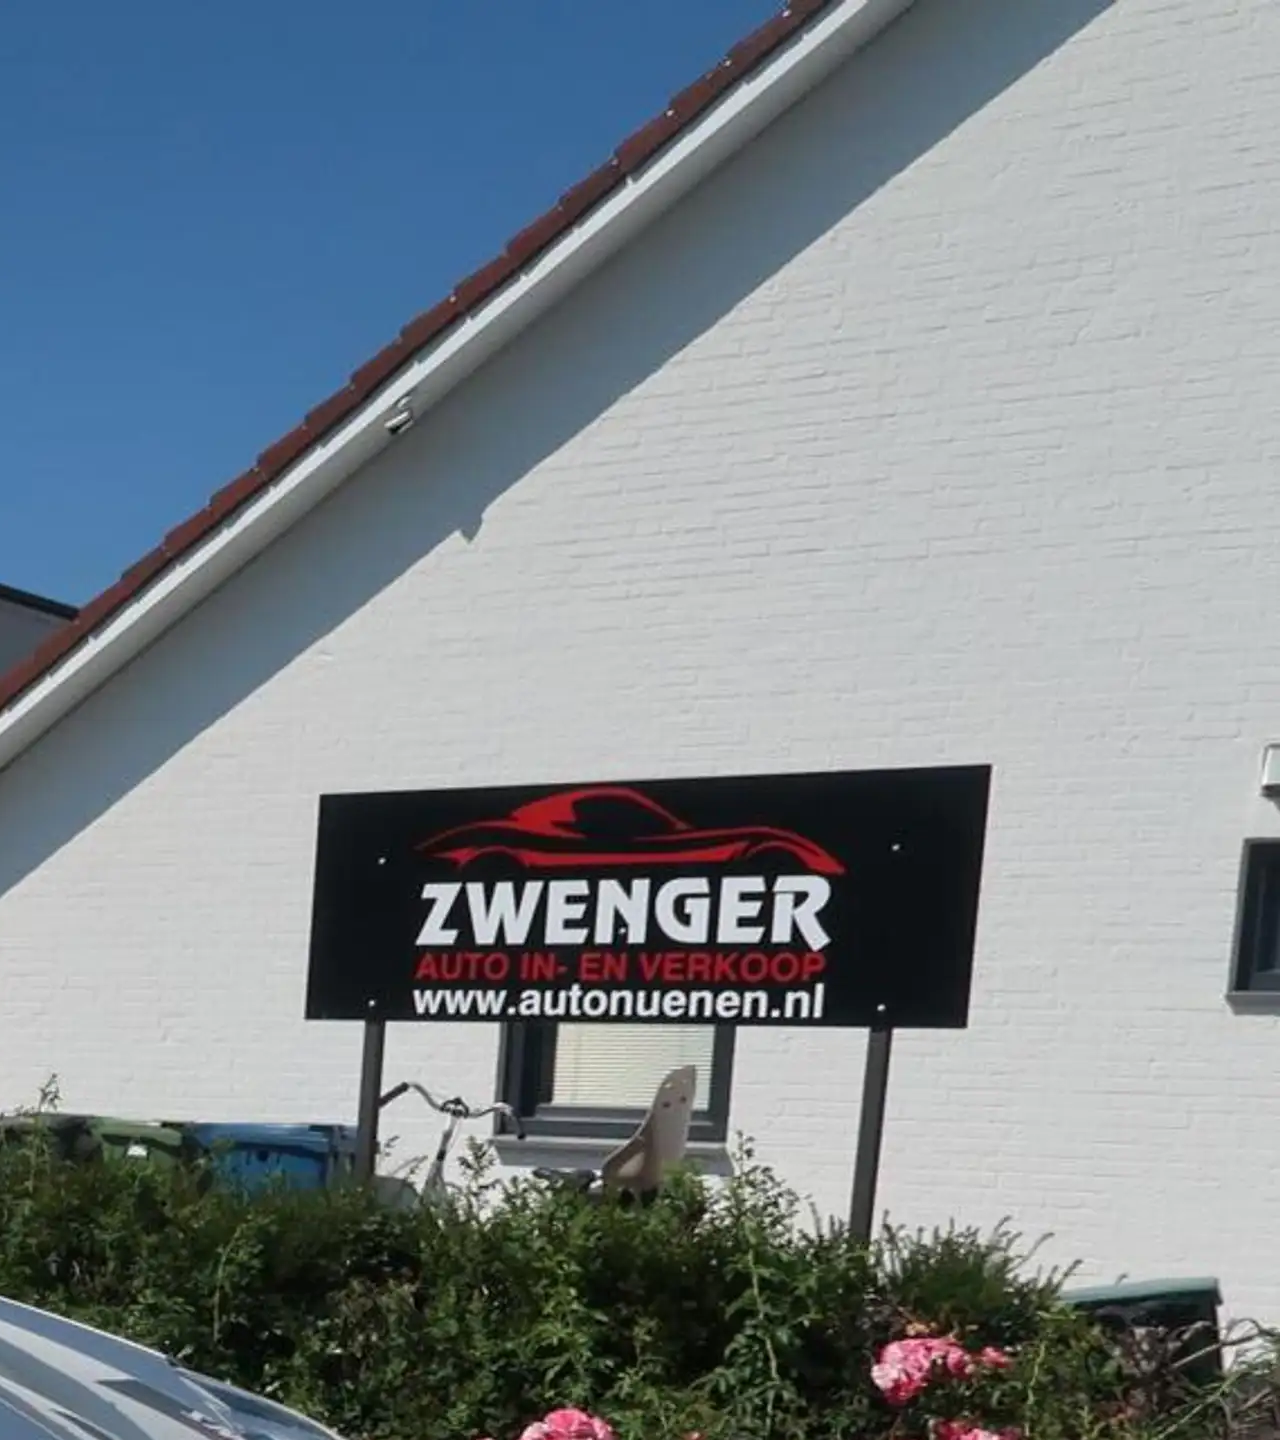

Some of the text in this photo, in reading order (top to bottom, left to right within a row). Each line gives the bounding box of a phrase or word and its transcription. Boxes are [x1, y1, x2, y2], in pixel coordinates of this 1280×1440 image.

[415, 875, 831, 952] ZWENGER
[415, 952, 826, 981] AUTO IN- EN VERKOOP
[413, 983, 825, 1018] www.autonuenen.nl
